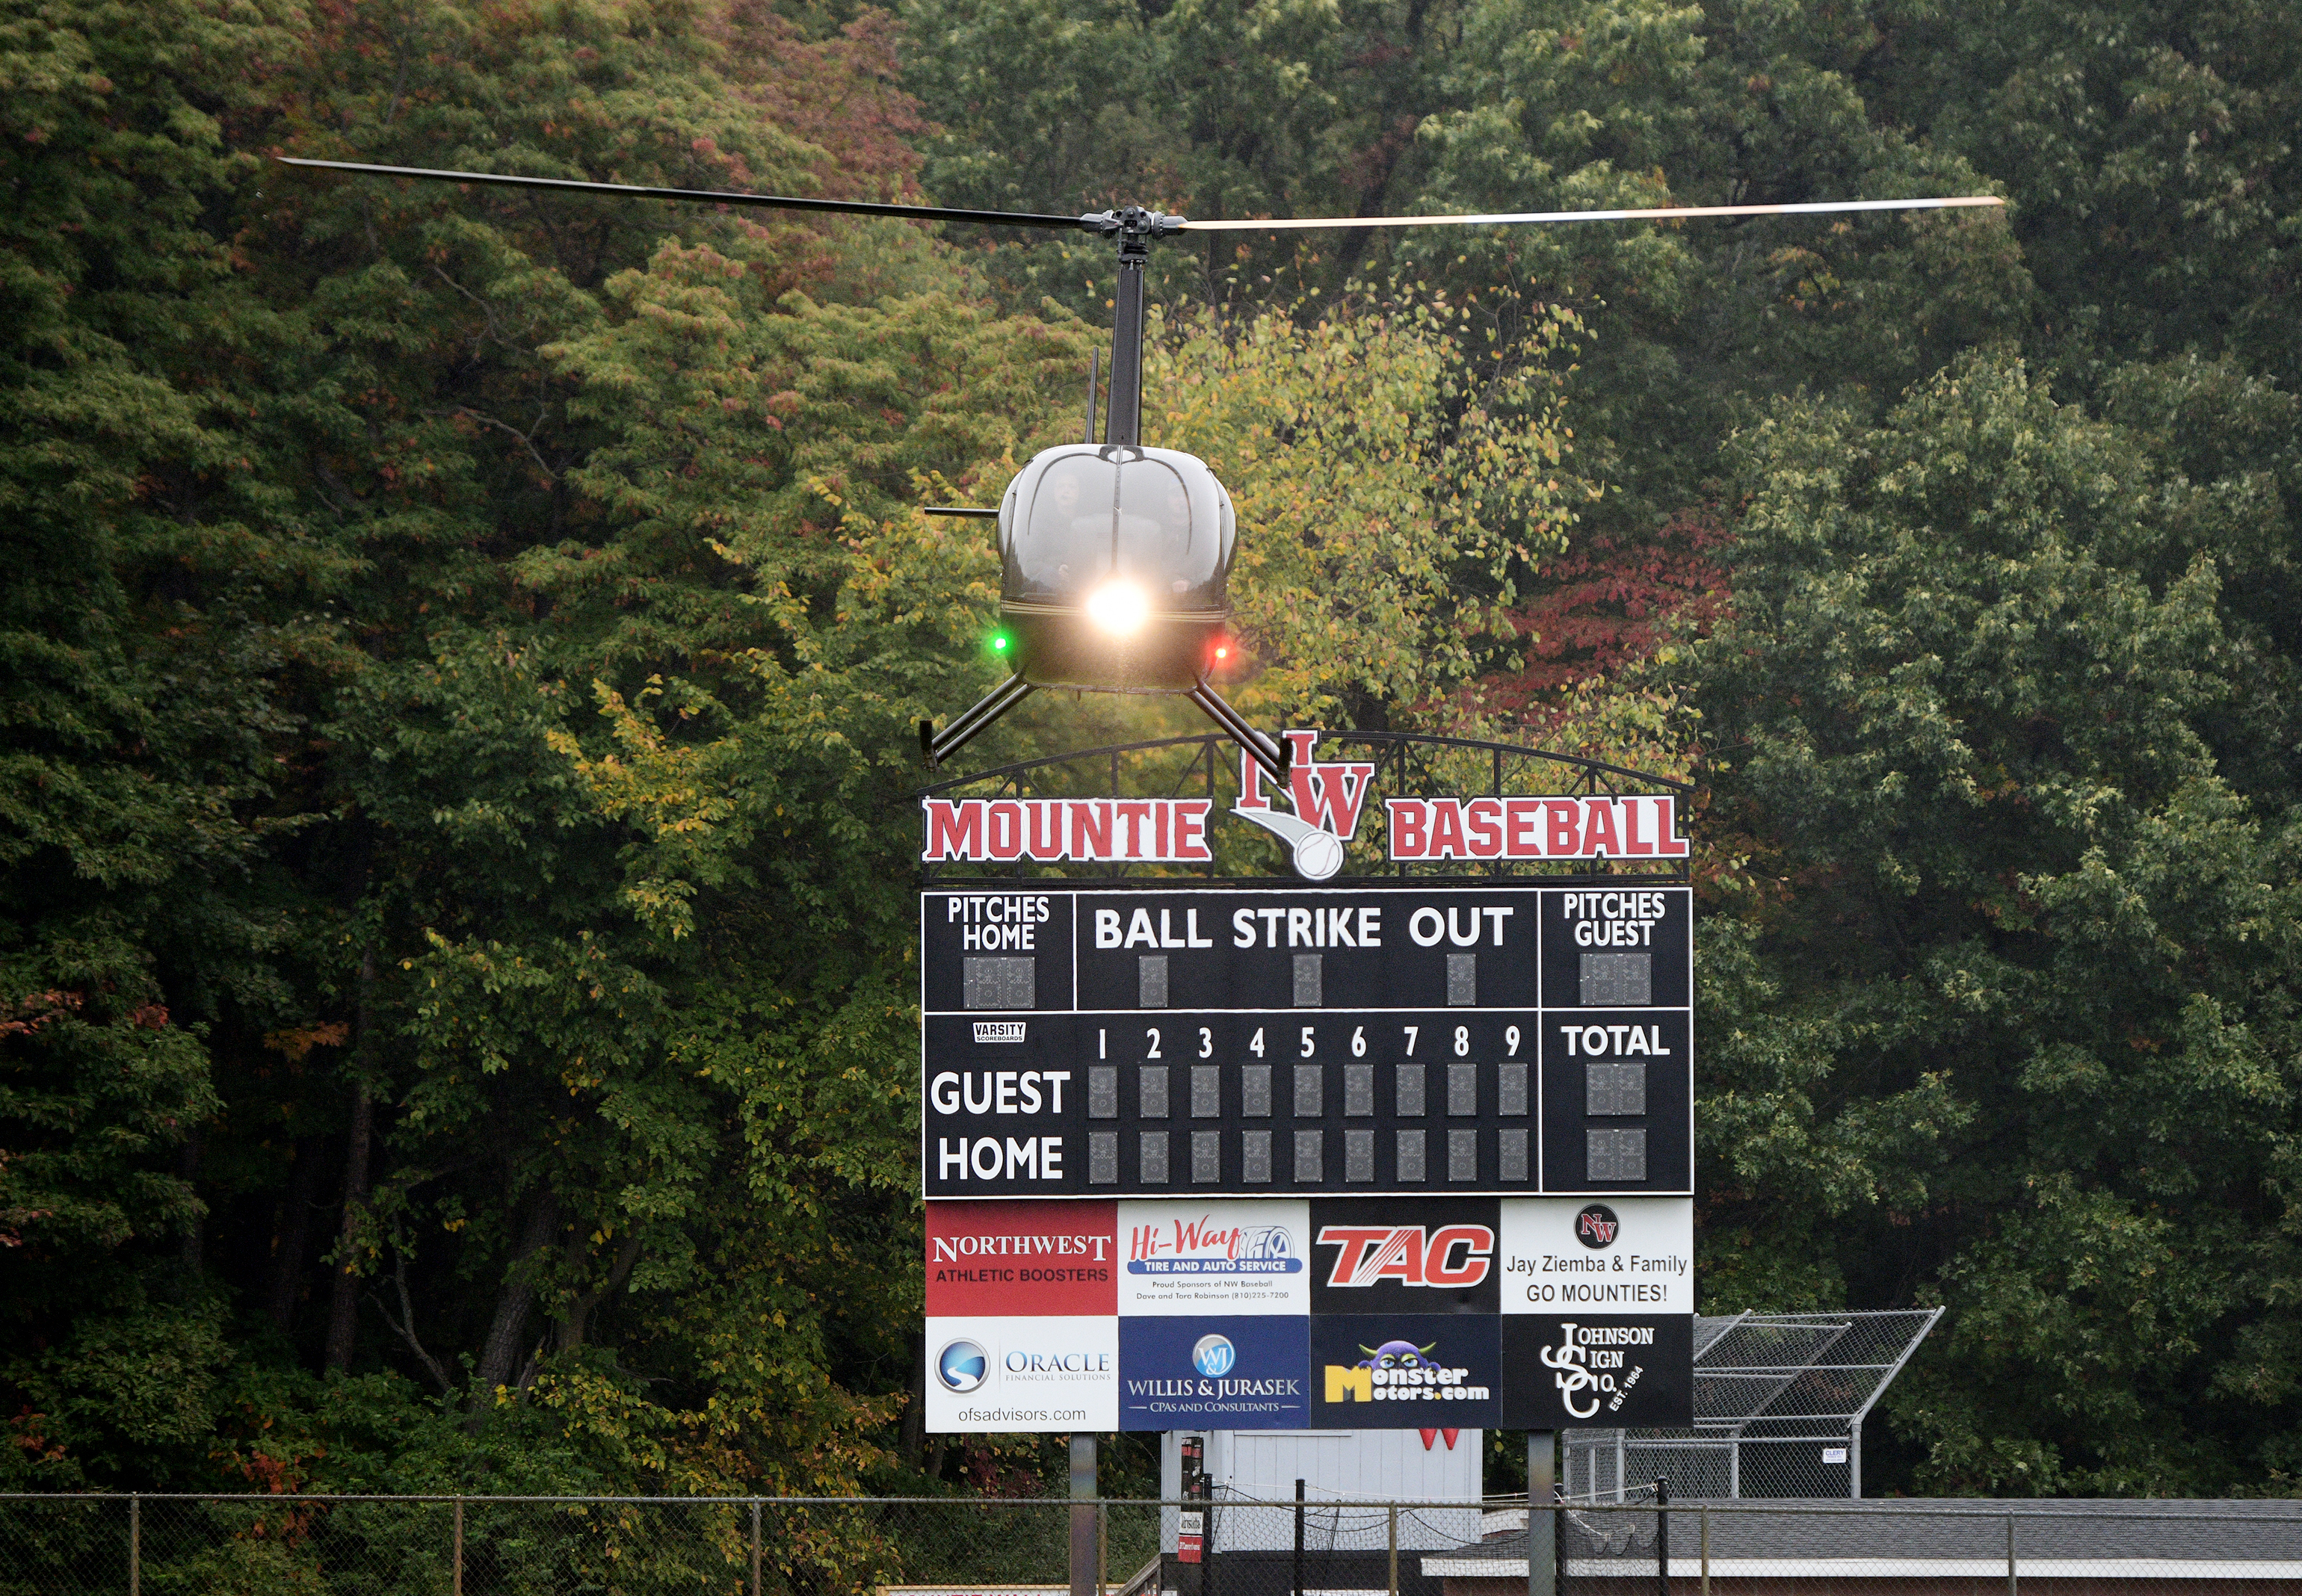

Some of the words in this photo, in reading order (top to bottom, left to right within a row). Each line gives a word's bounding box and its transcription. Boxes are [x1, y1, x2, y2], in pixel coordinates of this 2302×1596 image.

[922, 799, 1212, 861] MOUNTIE
[1386, 796, 1690, 860] BASEBALL
[948, 897, 1049, 924] PITCHES
[1564, 892, 1665, 919] PITCHES
[963, 924, 1035, 950] HOME
[1095, 909, 1213, 949] BALL
[1233, 908, 1381, 947] STRIKE
[1410, 906, 1513, 947] OUT
[1575, 920, 1655, 947] GUEST
[975, 1024, 1023, 1036] VARSITY
[1099, 1029, 1106, 1060] 1
[1147, 1028, 1161, 1059] 2
[1198, 1027, 1212, 1058] 3
[1250, 1027, 1265, 1057] 4
[1300, 1027, 1315, 1057] 5
[1351, 1026, 1366, 1057] 6
[1404, 1027, 1419, 1057] 7
[1454, 1026, 1469, 1057] 8
[1506, 1025, 1520, 1056] 9
[1561, 1025, 1670, 1056] TOTAL
[931, 1071, 1070, 1115] GUEST
[939, 1136, 1063, 1181] HOME
[1130, 1213, 1241, 1261] Hi-Way
[1581, 1213, 1617, 1243] NW
[932, 1235, 1111, 1262] NORTHWEST
[1316, 1225, 1495, 1288] TAC
[936, 1269, 1014, 1281] ATHLETIC
[1020, 1269, 1108, 1281] BOOSTERS
[1144, 1261, 1169, 1272] TIRE
[1173, 1261, 1200, 1272] AND
[1203, 1261, 1236, 1272] AUTO
[1239, 1261, 1286, 1271] SERVICE
[1507, 1255, 1537, 1276] Jay
[1542, 1255, 1605, 1272] Ziemba
[1612, 1255, 1624, 1272] &
[1631, 1255, 1688, 1276] Family
[1177, 1281, 1212, 1290] Sponsors
[1232, 1292, 1289, 1300] (810)225-7200
[1526, 1284, 1555, 1302] GO
[1562, 1284, 1667, 1302] MOUNTIES!
[1005, 1351, 1110, 1373] ORACLE
[1127, 1379, 1194, 1396] WILLIS
[1197, 1379, 1215, 1396] &
[1217, 1379, 1301, 1400] JURASEK
[1608, 1390, 1629, 1412] EST.
[1623, 1365, 1644, 1389] 1964
[958, 1407, 1086, 1421] ofsadvisors.com
[1179, 1403, 1203, 1412] AND
[1204, 1402, 1280, 1412] CONSULTANTS
